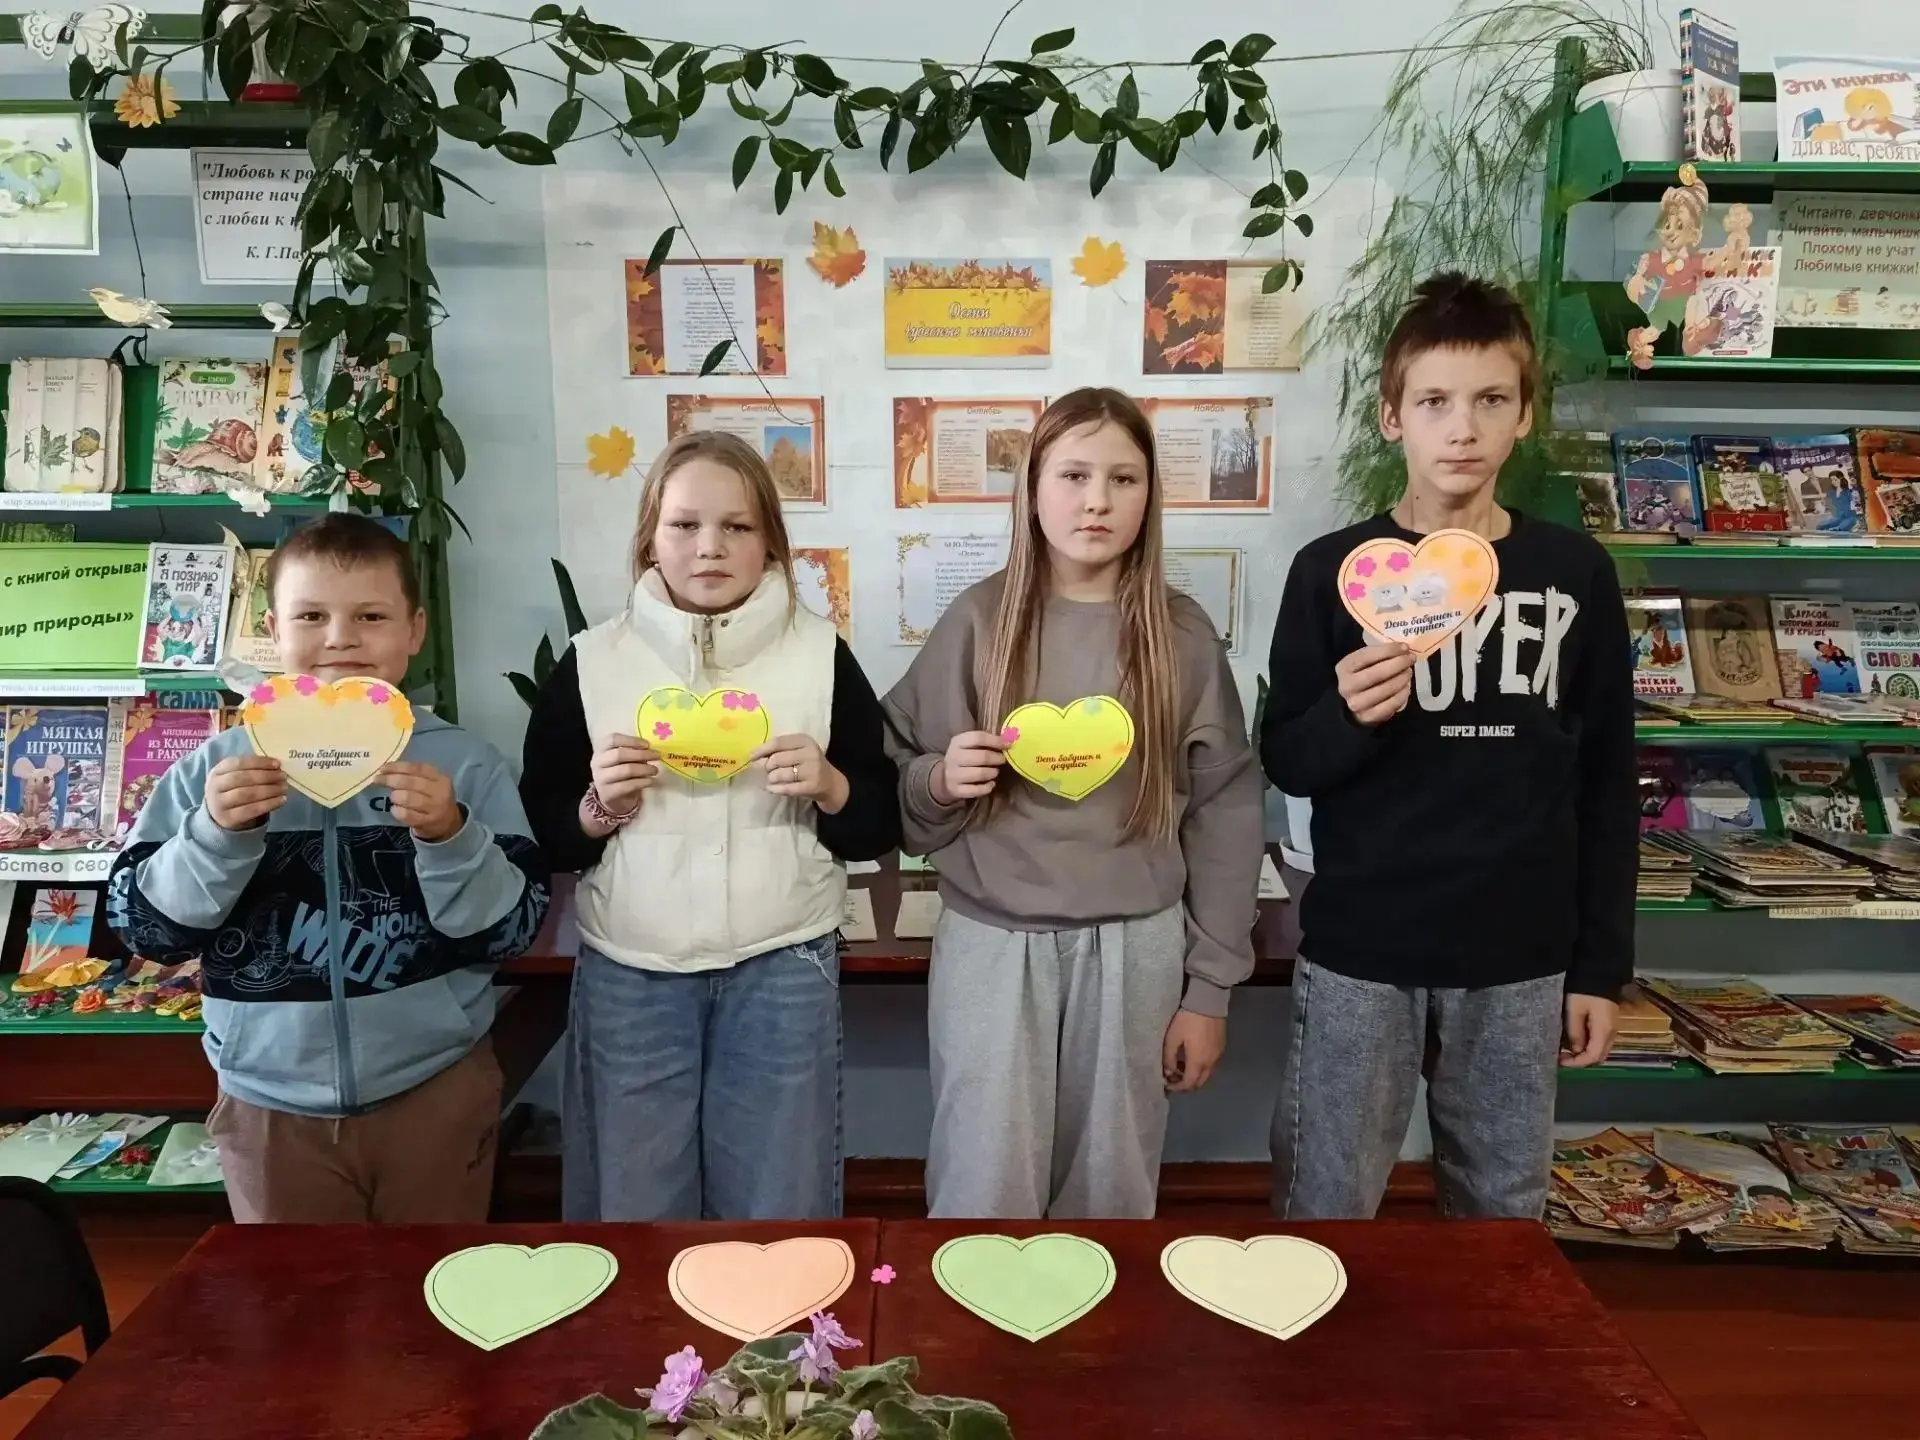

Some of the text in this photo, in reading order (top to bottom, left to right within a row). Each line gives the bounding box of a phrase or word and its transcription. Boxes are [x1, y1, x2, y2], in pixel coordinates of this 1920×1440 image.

[1782, 79, 1827, 95] Эти
[1792, 141, 1822, 157] для
[1830, 141, 1860, 159] вас,
[203, 163, 275, 179] "Любовь
[281, 167, 290, 179] к
[203, 189, 264, 205] стране
[204, 213, 213, 225] с
[217, 210, 269, 226] любви
[275, 214, 285, 226] к
[1797, 205, 1857, 219] Читайте,
[1788, 223, 1848, 238] Читайте,
[246, 246, 260, 259] К.
[1803, 241, 1915, 257] Плохому не учат
[1794, 259, 1919, 275] Любимые книжки!
[4, 576, 13, 587] с
[17, 566, 71, 586] книгой
[160, 568, 218, 582] Я ПОЗНАЮ
[175, 581, 201, 592] МИР
[33, 611, 134, 634] природы»
[1384, 619, 1409, 630] День
[1410, 610, 1453, 627] бабушек
[1403, 620, 1447, 636] дедушек
[1414, 585, 1580, 712] UPER
[42, 726, 104, 740] МЯГКАЯ
[1440, 725, 1516, 738] SUPER IMAGE
[26, 741, 103, 755] ИГРУШКА
[288, 749, 314, 759] День
[316, 749, 361, 763] бабушек
[1036, 755, 1056, 763] День
[1058, 753, 1094, 763] бабушек
[307, 760, 352, 769] дедушек
[1050, 762, 1088, 771] дедушек
[371, 897, 401, 912] THE
